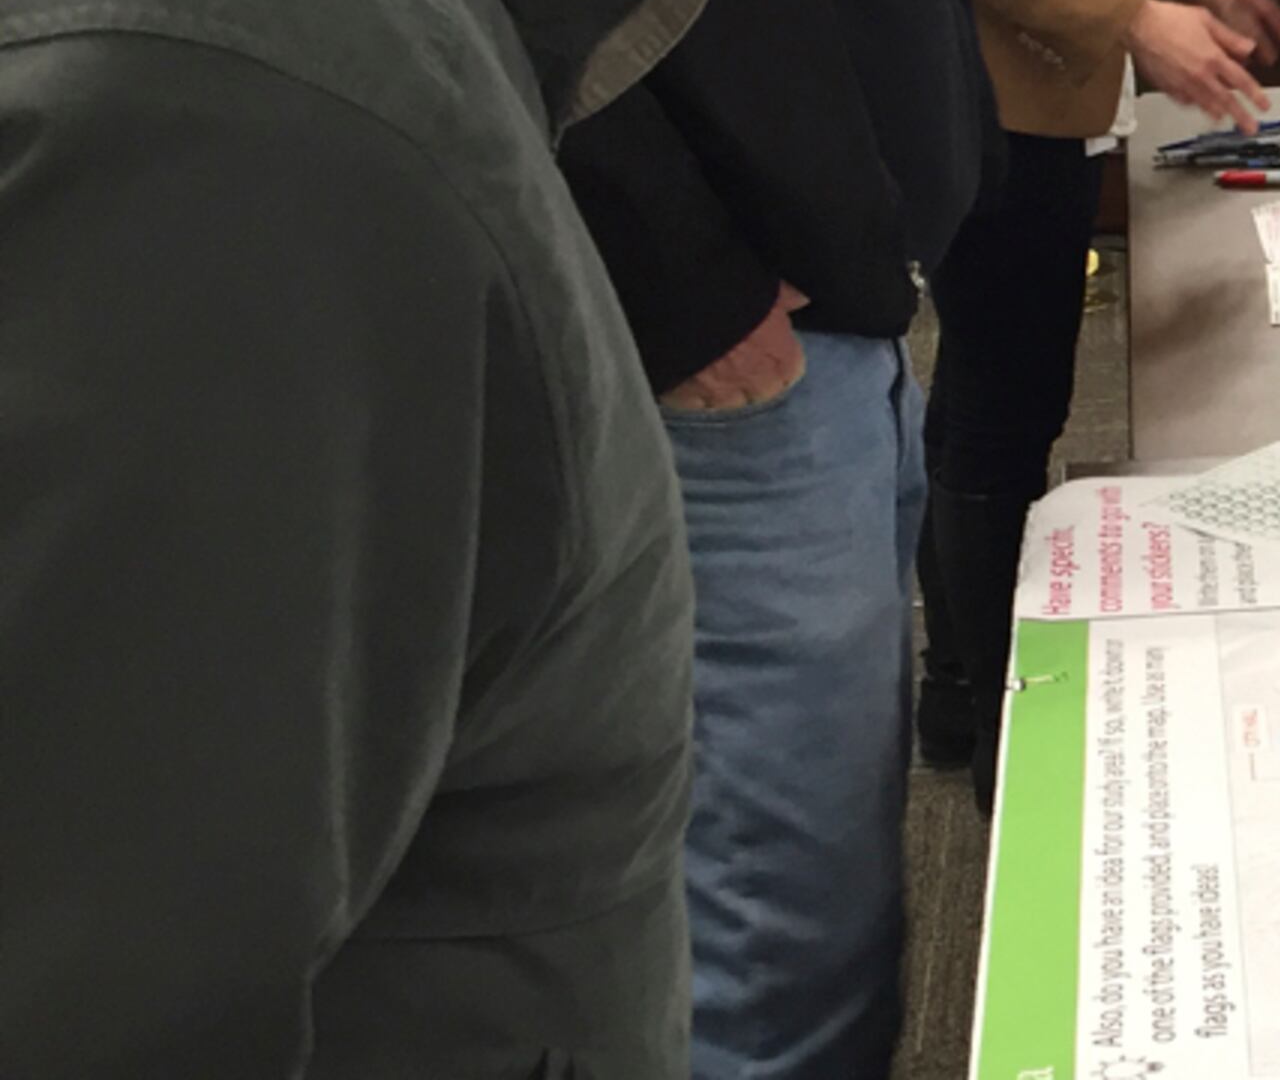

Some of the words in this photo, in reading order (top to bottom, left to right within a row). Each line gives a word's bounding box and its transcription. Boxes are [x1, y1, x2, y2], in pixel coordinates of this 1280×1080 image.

[1101, 506, 1130, 521] go
[1098, 523, 1123, 538] to
[1142, 522, 1173, 580] stickers?
[1098, 541, 1123, 612] comments
[1042, 581, 1072, 615] Have
[1149, 581, 1180, 609] your
[1141, 683, 1166, 705] Use
[1098, 750, 1124, 777] area?
[1141, 740, 1168, 762] the
[1097, 780, 1132, 807] study
[1142, 790, 1175, 819] place
[1103, 810, 1124, 831] our
[1095, 834, 1124, 856] for
[1141, 821, 1170, 850] and
[1095, 857, 1123, 888] idea
[1143, 853, 1179, 916] provided,
[1190, 864, 1220, 903] ideas!
[1103, 891, 1123, 906] an
[1093, 909, 1123, 948] have
[1142, 918, 1181, 955] flags
[1192, 906, 1223, 939] have
[1100, 949, 1131, 982] you
[1201, 940, 1232, 971] you
[1144, 958, 1175, 986] the
[1201, 973, 1227, 990] as
[1092, 983, 1123, 1003] do
[1143, 987, 1174, 1005] of
[1091, 1005, 1126, 1047] Also,
[1150, 1007, 1176, 1042] one
[1194, 993, 1236, 1038] flags
